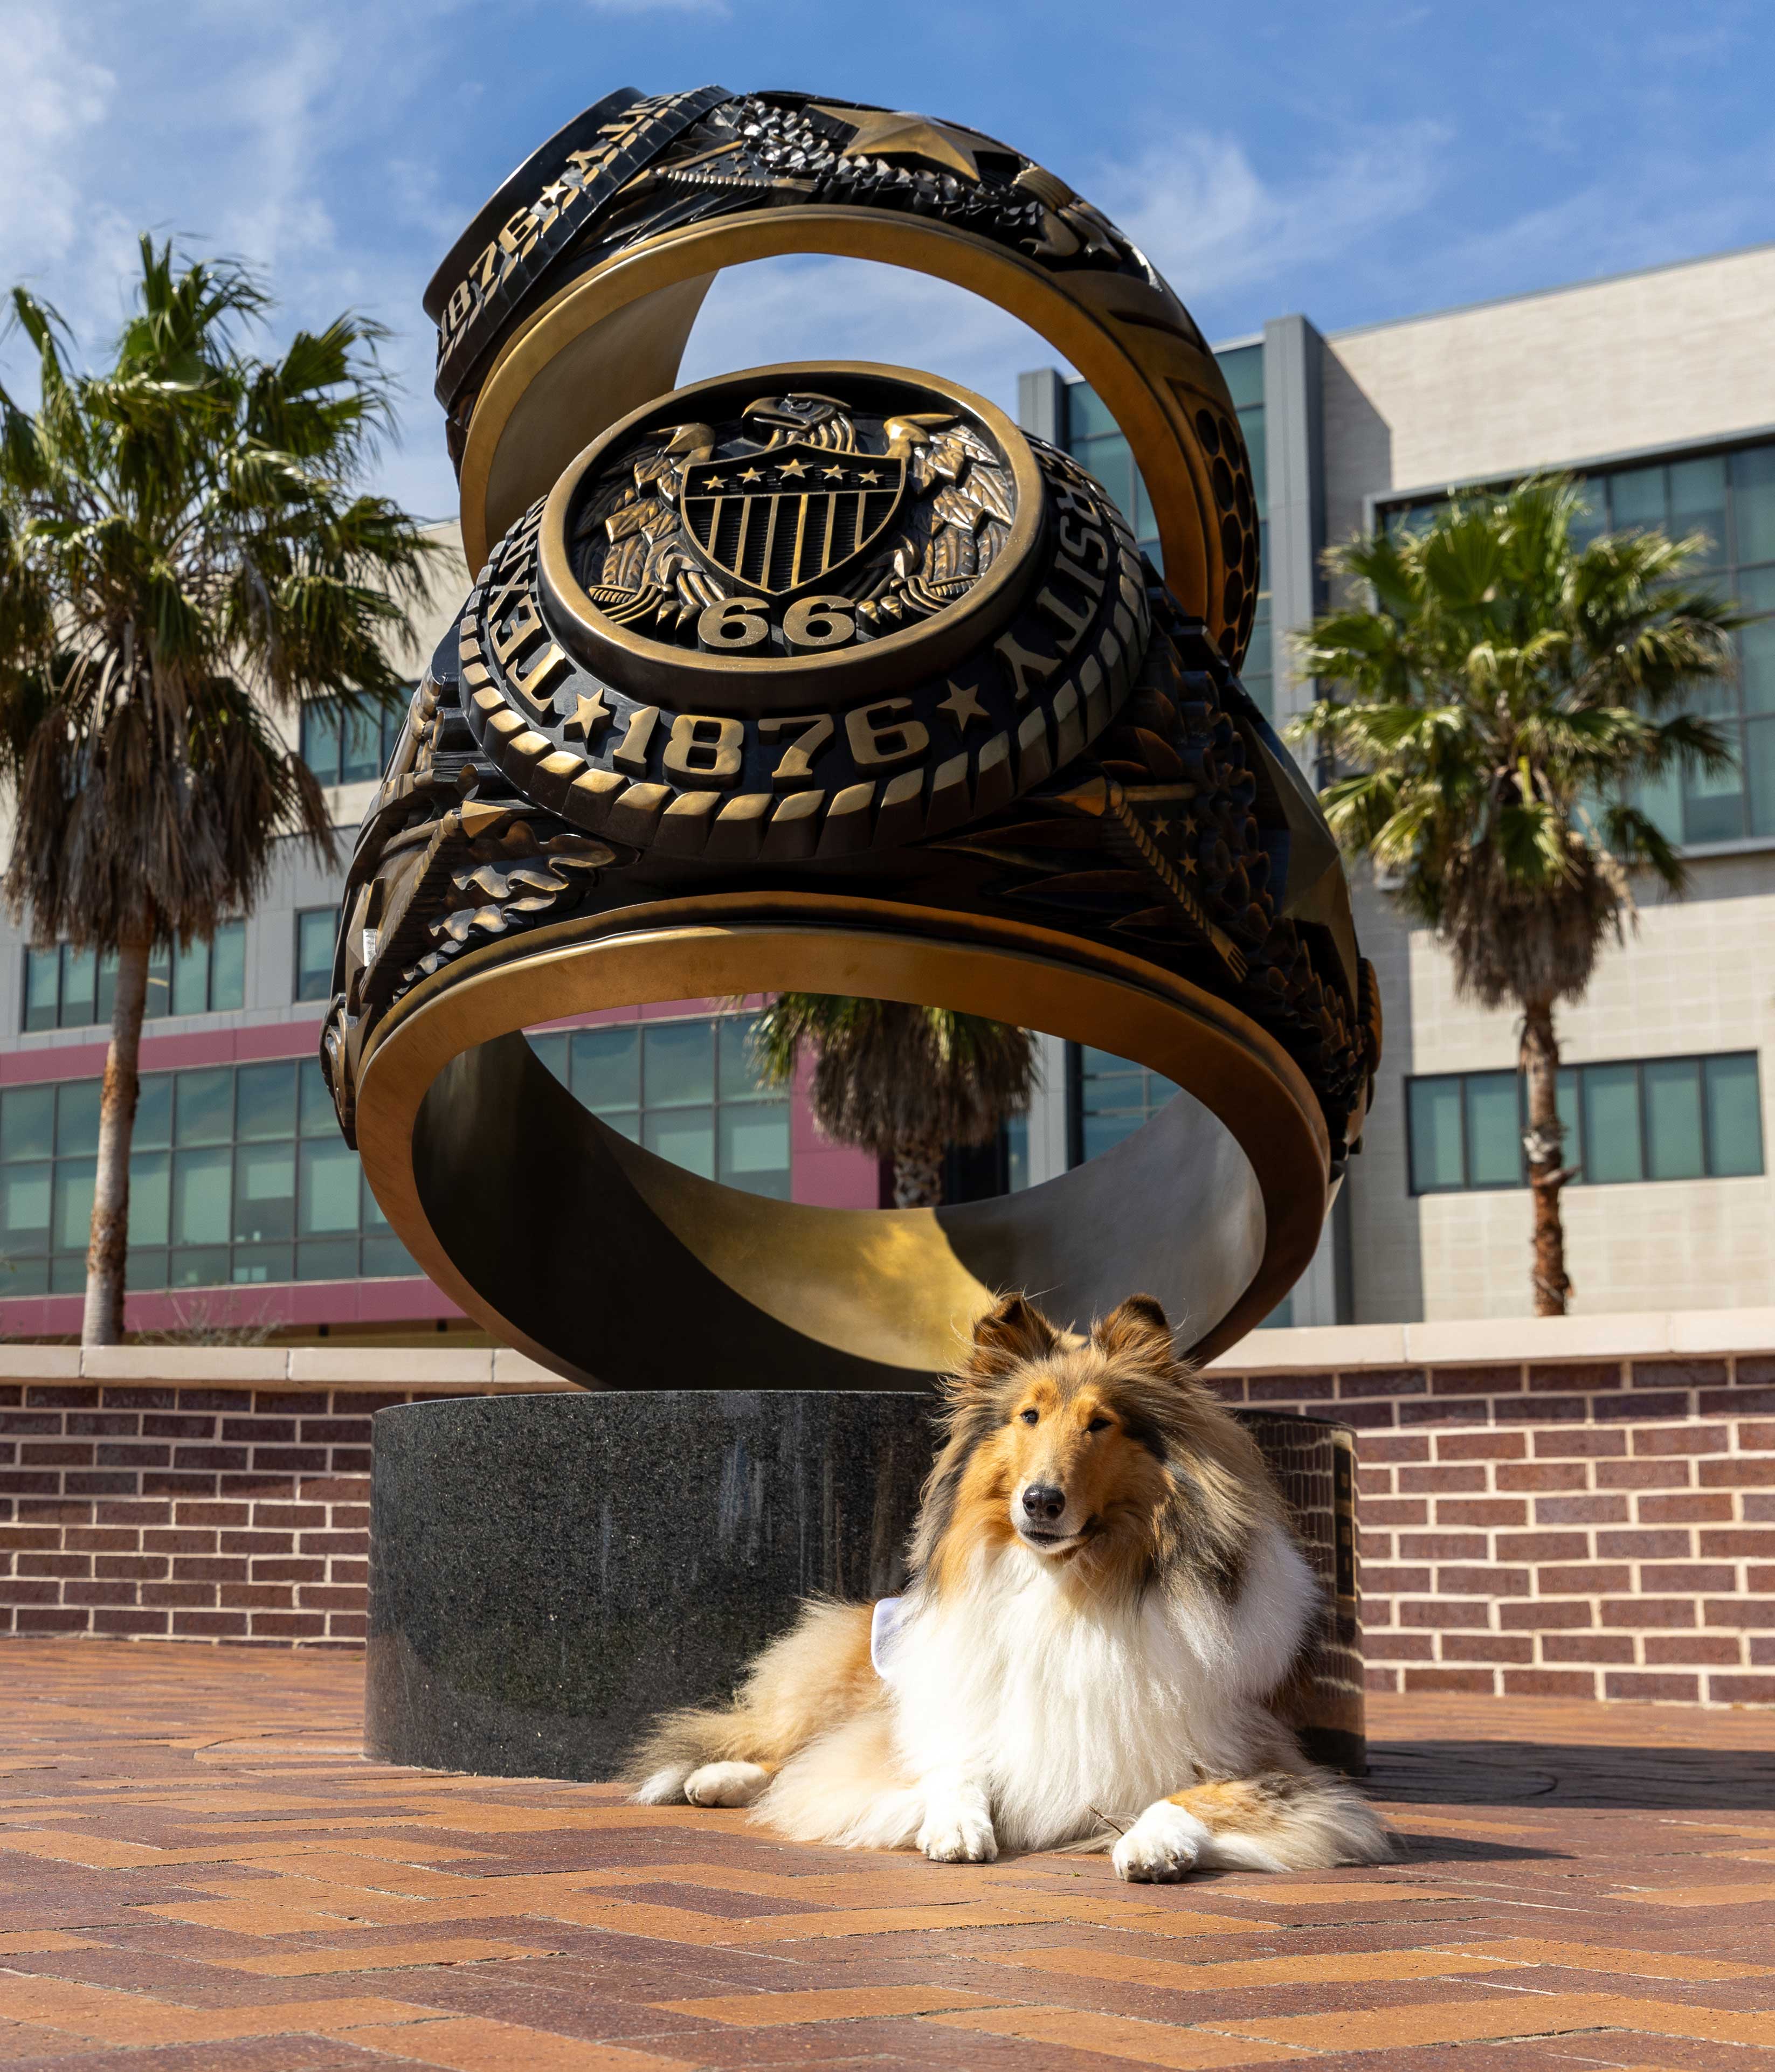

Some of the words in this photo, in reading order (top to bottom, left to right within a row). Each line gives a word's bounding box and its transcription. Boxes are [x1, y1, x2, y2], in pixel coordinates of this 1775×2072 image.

[441, 206, 540, 349] 1876
[697, 595, 855, 647] 66
[612, 697, 930, 779] 1876
